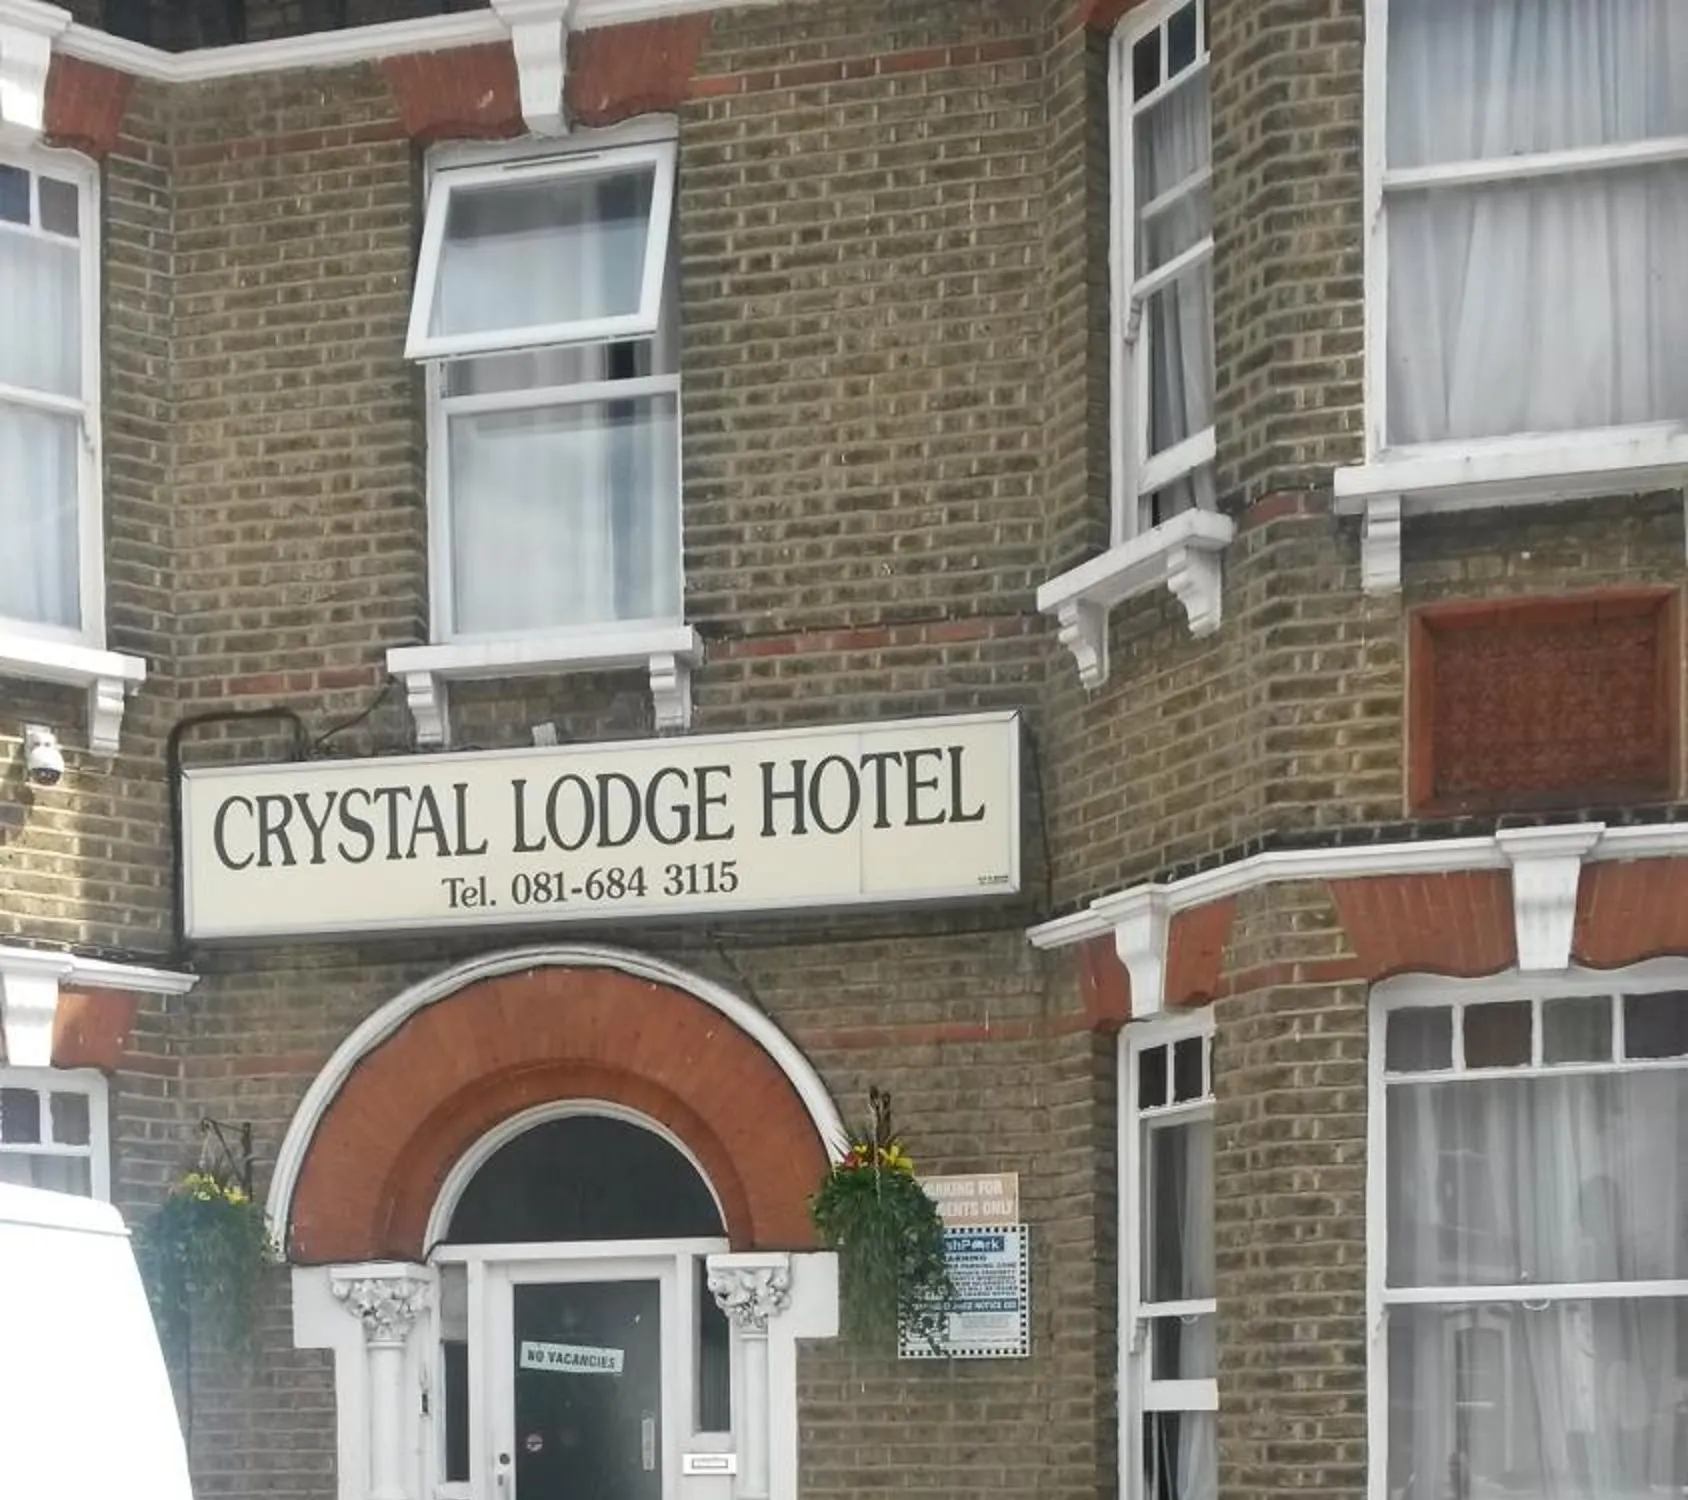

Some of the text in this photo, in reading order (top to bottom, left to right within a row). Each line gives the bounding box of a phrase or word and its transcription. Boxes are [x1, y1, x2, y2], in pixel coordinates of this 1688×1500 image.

[213, 745, 986, 871] CRYSTAL LODGE HOTEL
[441, 861, 739, 908] Tel. 081-684 3115
[527, 1349, 615, 1369] NO VACANCIES
